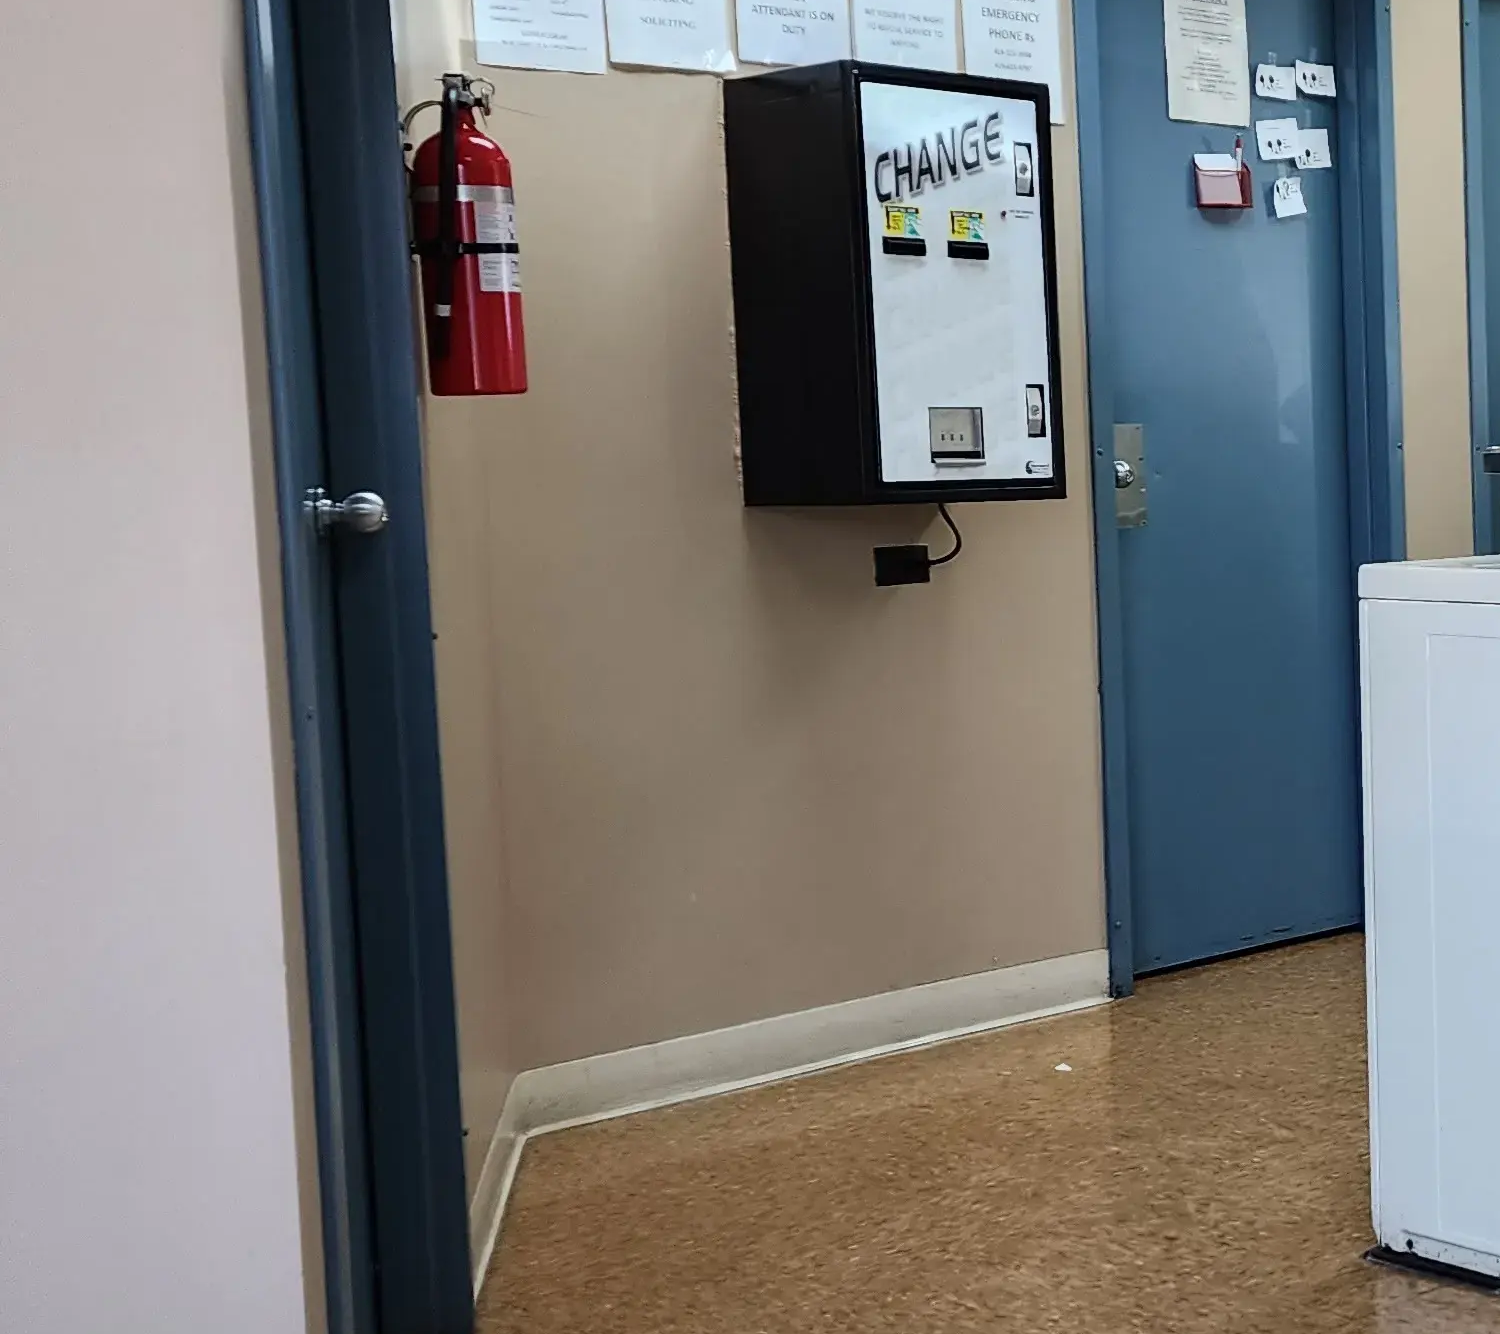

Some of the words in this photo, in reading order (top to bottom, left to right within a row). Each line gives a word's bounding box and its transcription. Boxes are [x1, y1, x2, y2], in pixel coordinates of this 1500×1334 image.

[751, 4, 806, 19] ATTENDANT
[808, 10, 817, 20] IS
[820, 11, 835, 21] ON
[981, 6, 1041, 24] EMERGENCY
[639, 16, 697, 30] SOLICITING
[782, 24, 806, 36] DUTY
[988, 27, 1022, 42] PHONE
[874, 111, 1004, 204] CHANGE
